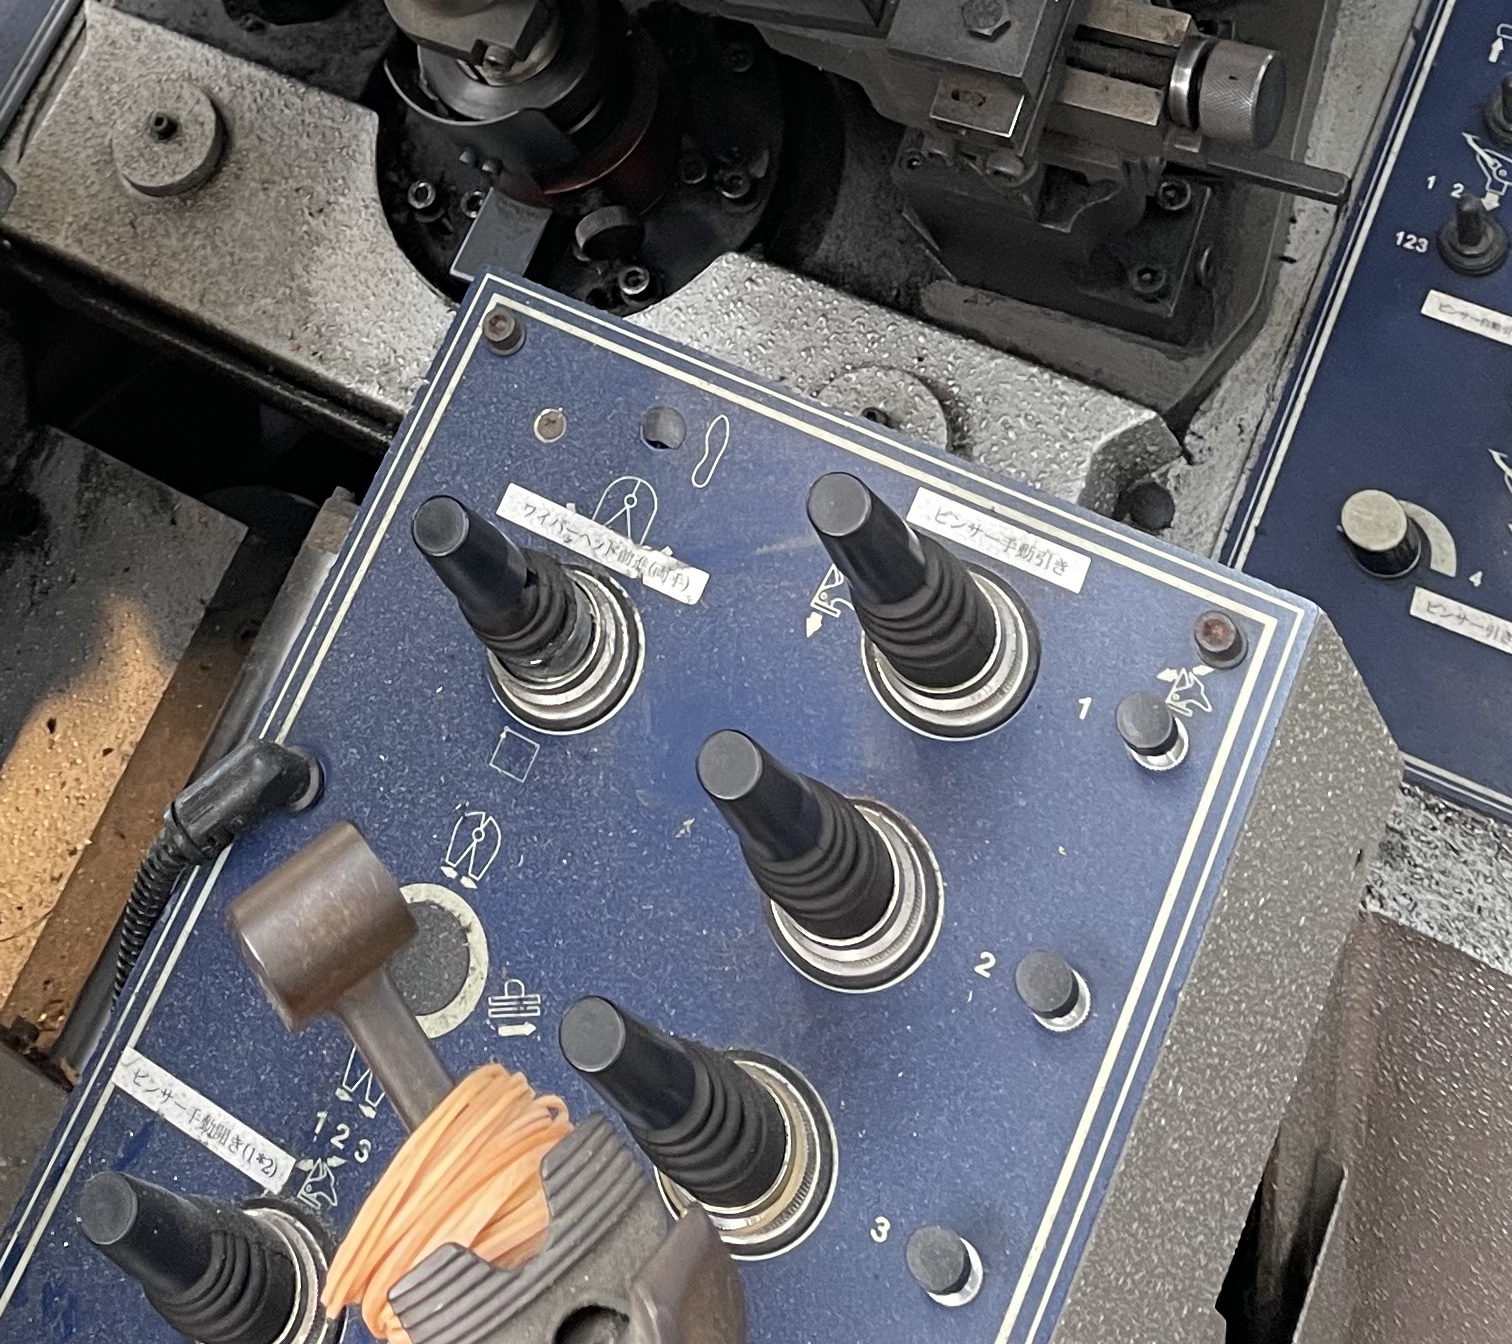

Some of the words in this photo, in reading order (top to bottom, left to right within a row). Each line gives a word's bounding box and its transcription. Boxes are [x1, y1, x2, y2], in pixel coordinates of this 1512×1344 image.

[1426, 175, 1437, 190] 1
[1450, 183, 1465, 199] 2
[1395, 230, 1430, 254] 123
[934, 505, 1070, 577] ピンサー手動引き
[1077, 696, 1093, 721] 1
[973, 950, 998, 979] 2
[312, 1110, 328, 1135] 1
[329, 1122, 351, 1150] 2
[353, 1137, 373, 1164] 3
[870, 1216, 891, 1243] 3
